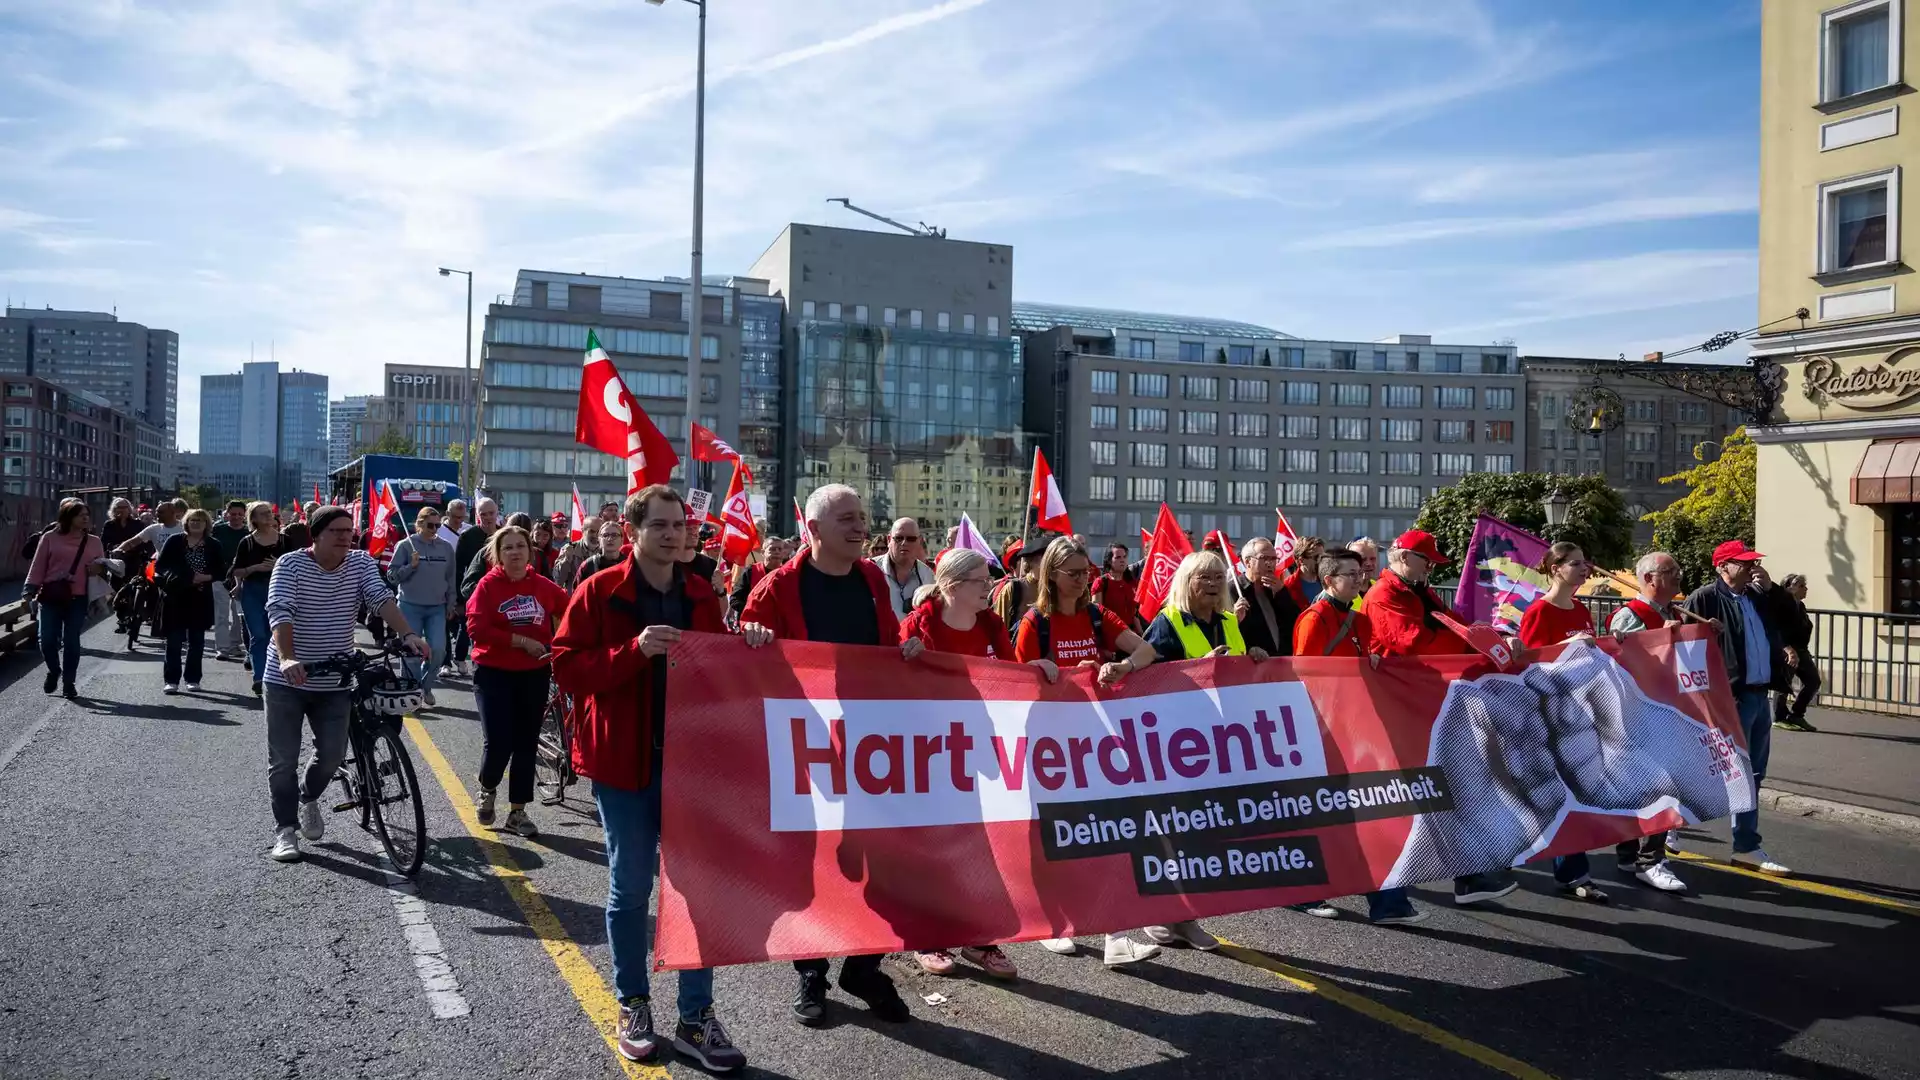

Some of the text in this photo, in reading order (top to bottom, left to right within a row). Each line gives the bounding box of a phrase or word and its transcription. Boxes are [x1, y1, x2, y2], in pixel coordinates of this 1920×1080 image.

[392, 373, 437, 387] capri
[1802, 355, 1920, 397] Radeberge
[1679, 670, 1708, 688] DGB
[790, 705, 1302, 795] Hart verdient!
[1698, 731, 1723, 747] MACH
[1709, 738, 1737, 761] DICH
[1054, 774, 1443, 848] Deine Arbeit. Deine Gesundheit.
[1143, 845, 1314, 883] Deine Rente.
